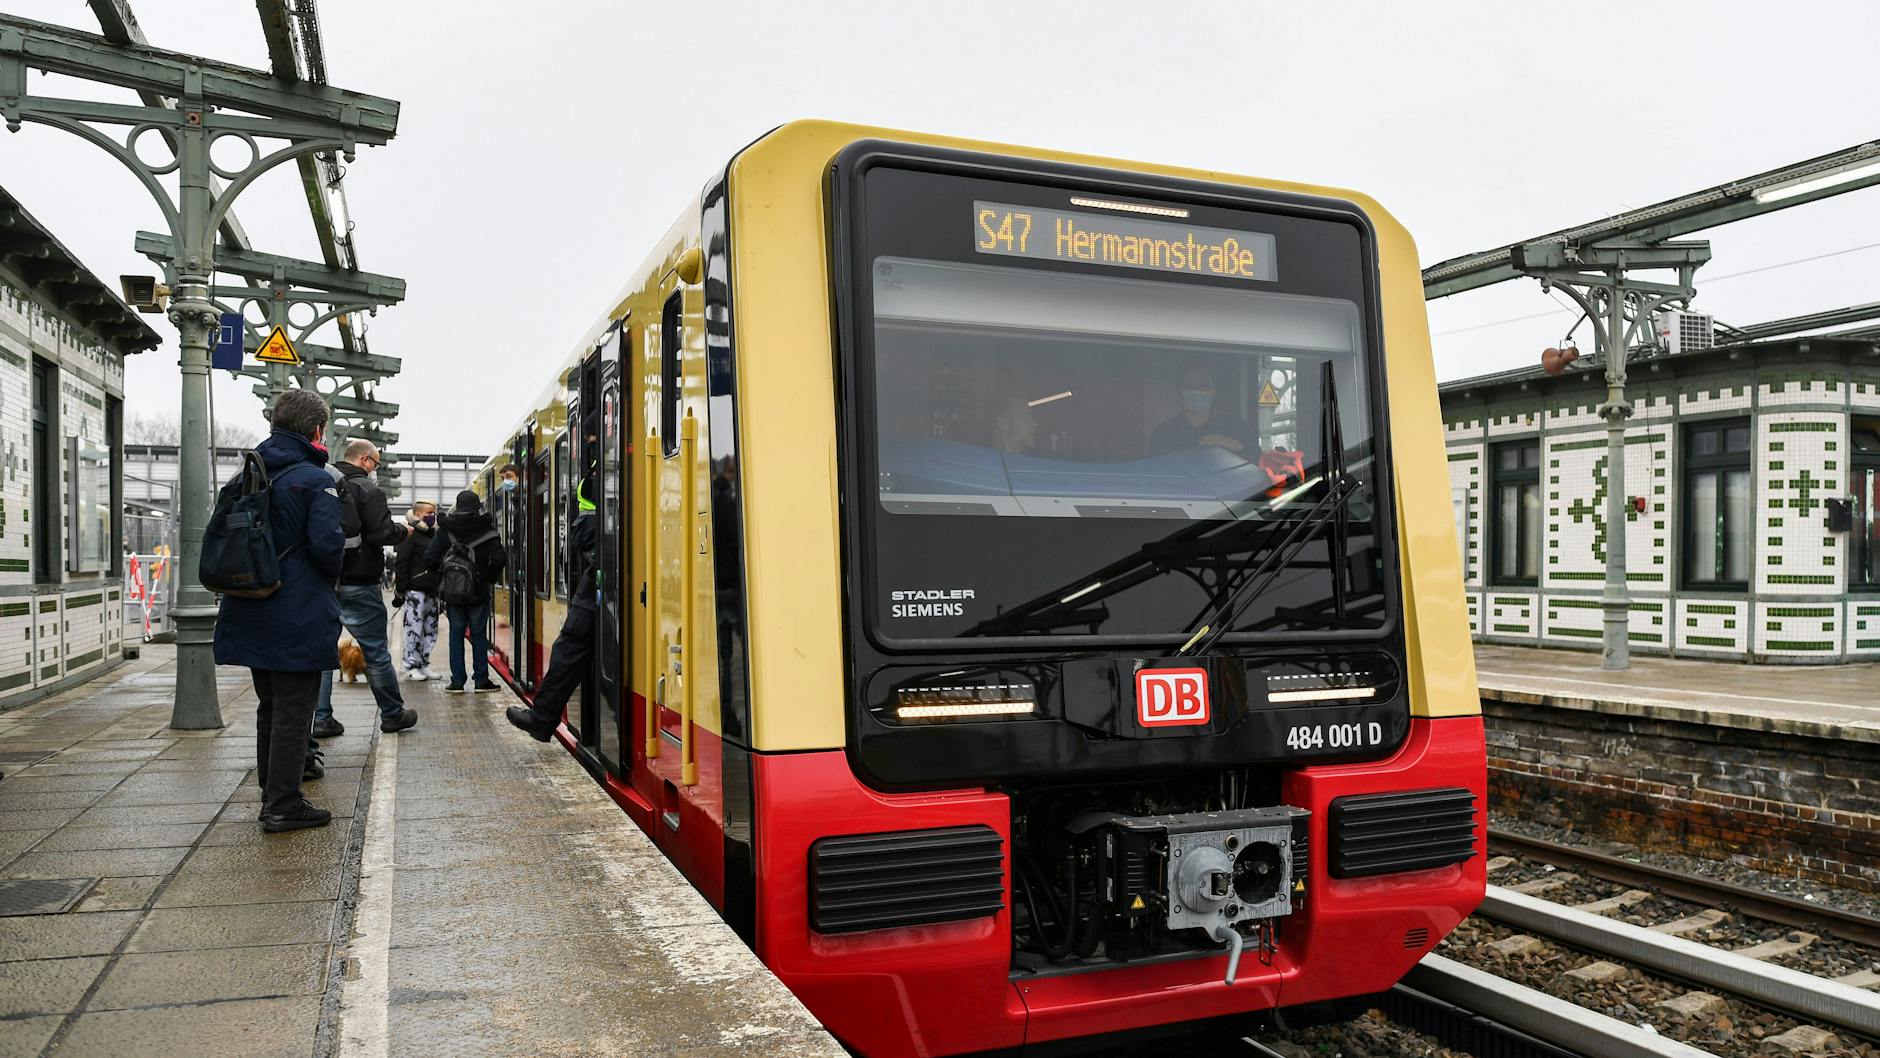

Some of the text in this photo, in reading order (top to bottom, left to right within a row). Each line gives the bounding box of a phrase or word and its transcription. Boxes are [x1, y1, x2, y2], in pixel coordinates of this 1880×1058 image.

[979, 209, 1254, 277] S47 Hermannstraße
[891, 589, 975, 601] STADLER
[892, 602, 964, 618] SIEMENS
[1146, 678, 1201, 717] DB
[1286, 722, 1382, 750] 484 001 D
